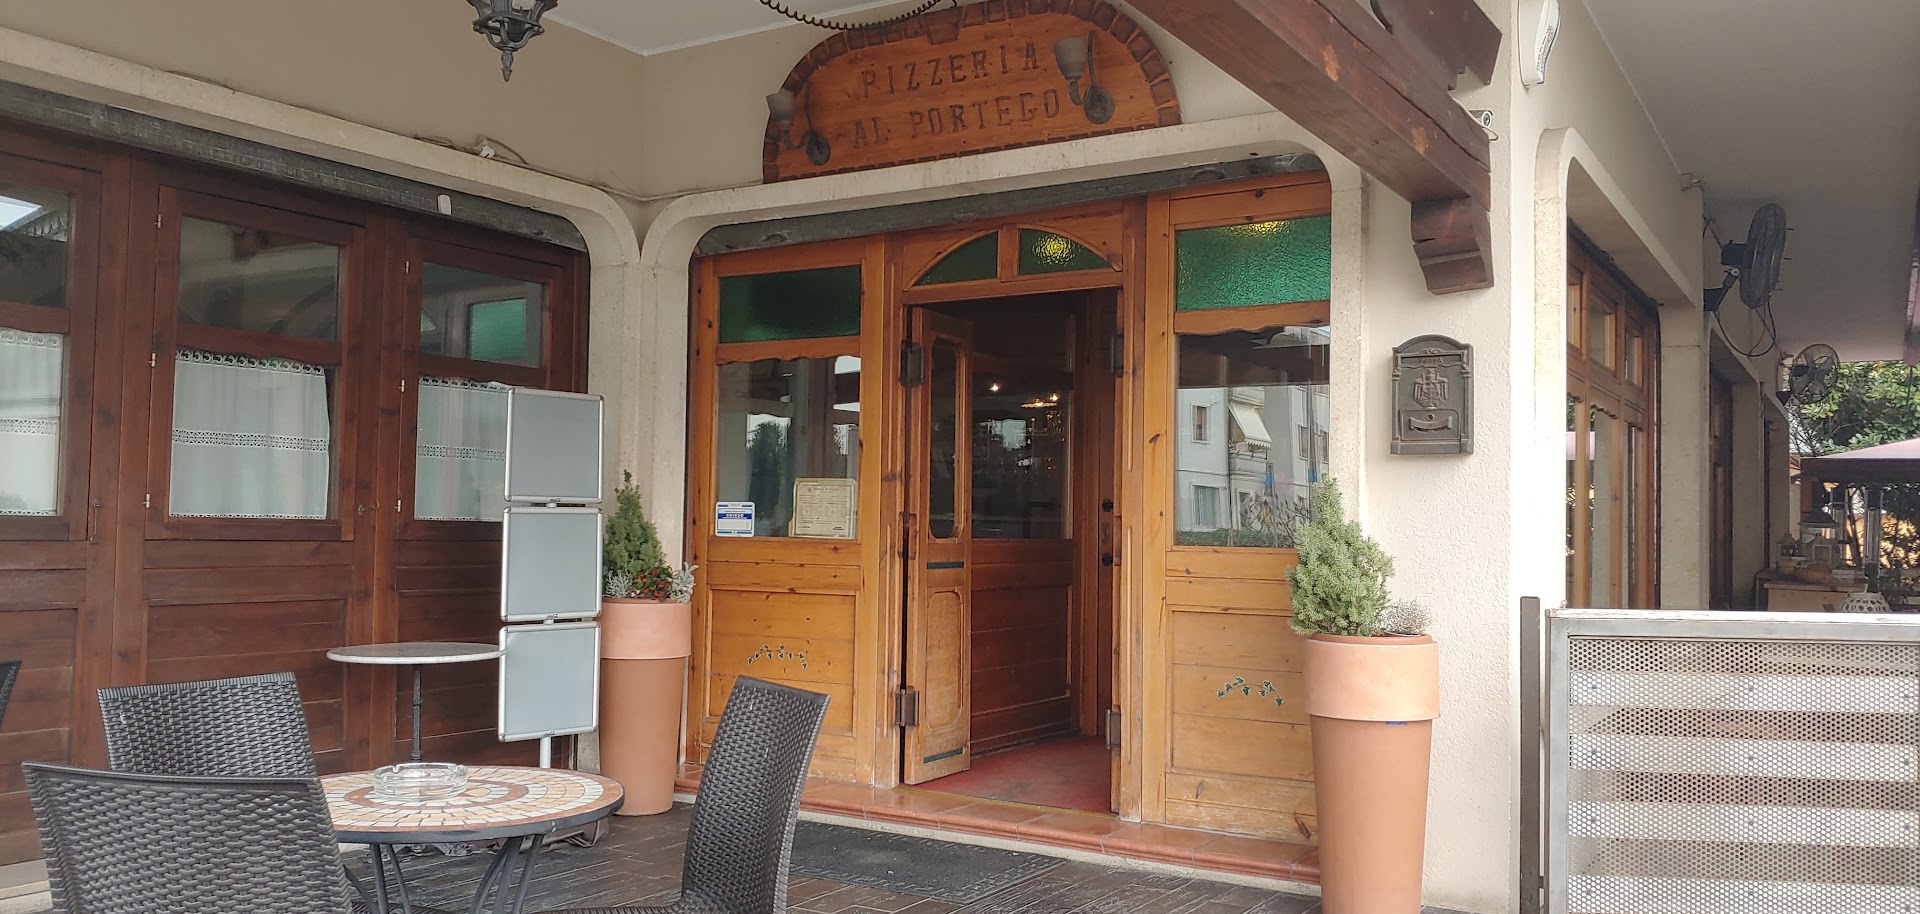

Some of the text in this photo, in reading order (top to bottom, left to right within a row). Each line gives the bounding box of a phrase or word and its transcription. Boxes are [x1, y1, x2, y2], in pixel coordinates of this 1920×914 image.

[861, 36, 1039, 98] PIZZERIA
[853, 88, 1060, 148] AL PORTEGO
